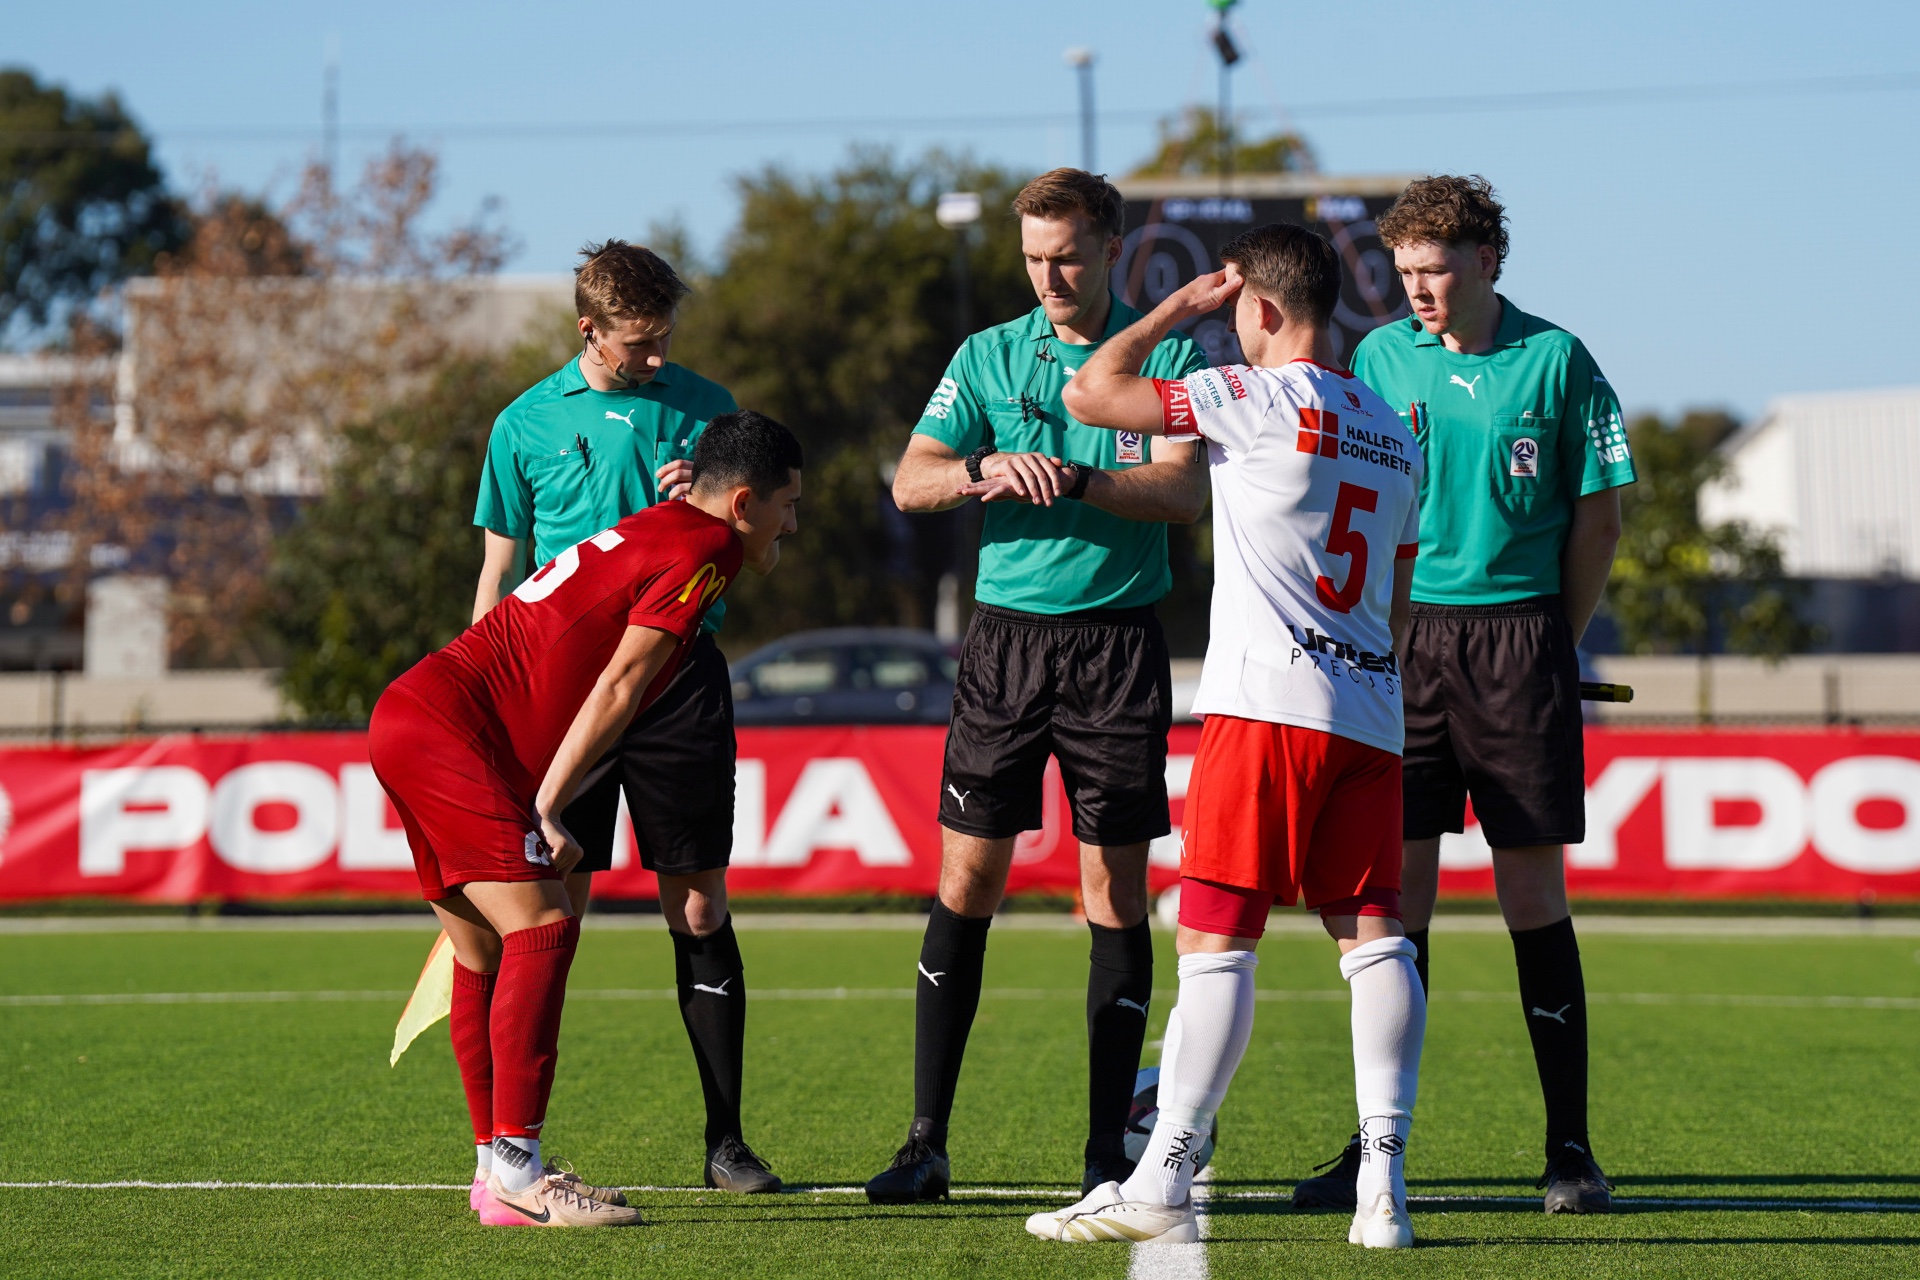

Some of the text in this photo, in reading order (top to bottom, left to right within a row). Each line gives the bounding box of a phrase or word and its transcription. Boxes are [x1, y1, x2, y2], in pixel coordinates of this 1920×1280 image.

[1169, 379, 1189, 426] TAIN
[1202, 373, 1223, 408] EASTERN
[1220, 366, 1248, 400] OLZON
[1340, 440, 1412, 476] CONCRETE
[1346, 424, 1404, 455] HALLETT
[1315, 481, 1379, 615] 5
[1290, 647, 1401, 695] PRECS
[80, 757, 915, 876] POLIA
[1163, 1130, 1193, 1172] YNE
[1359, 1120, 1371, 1163] YNE
